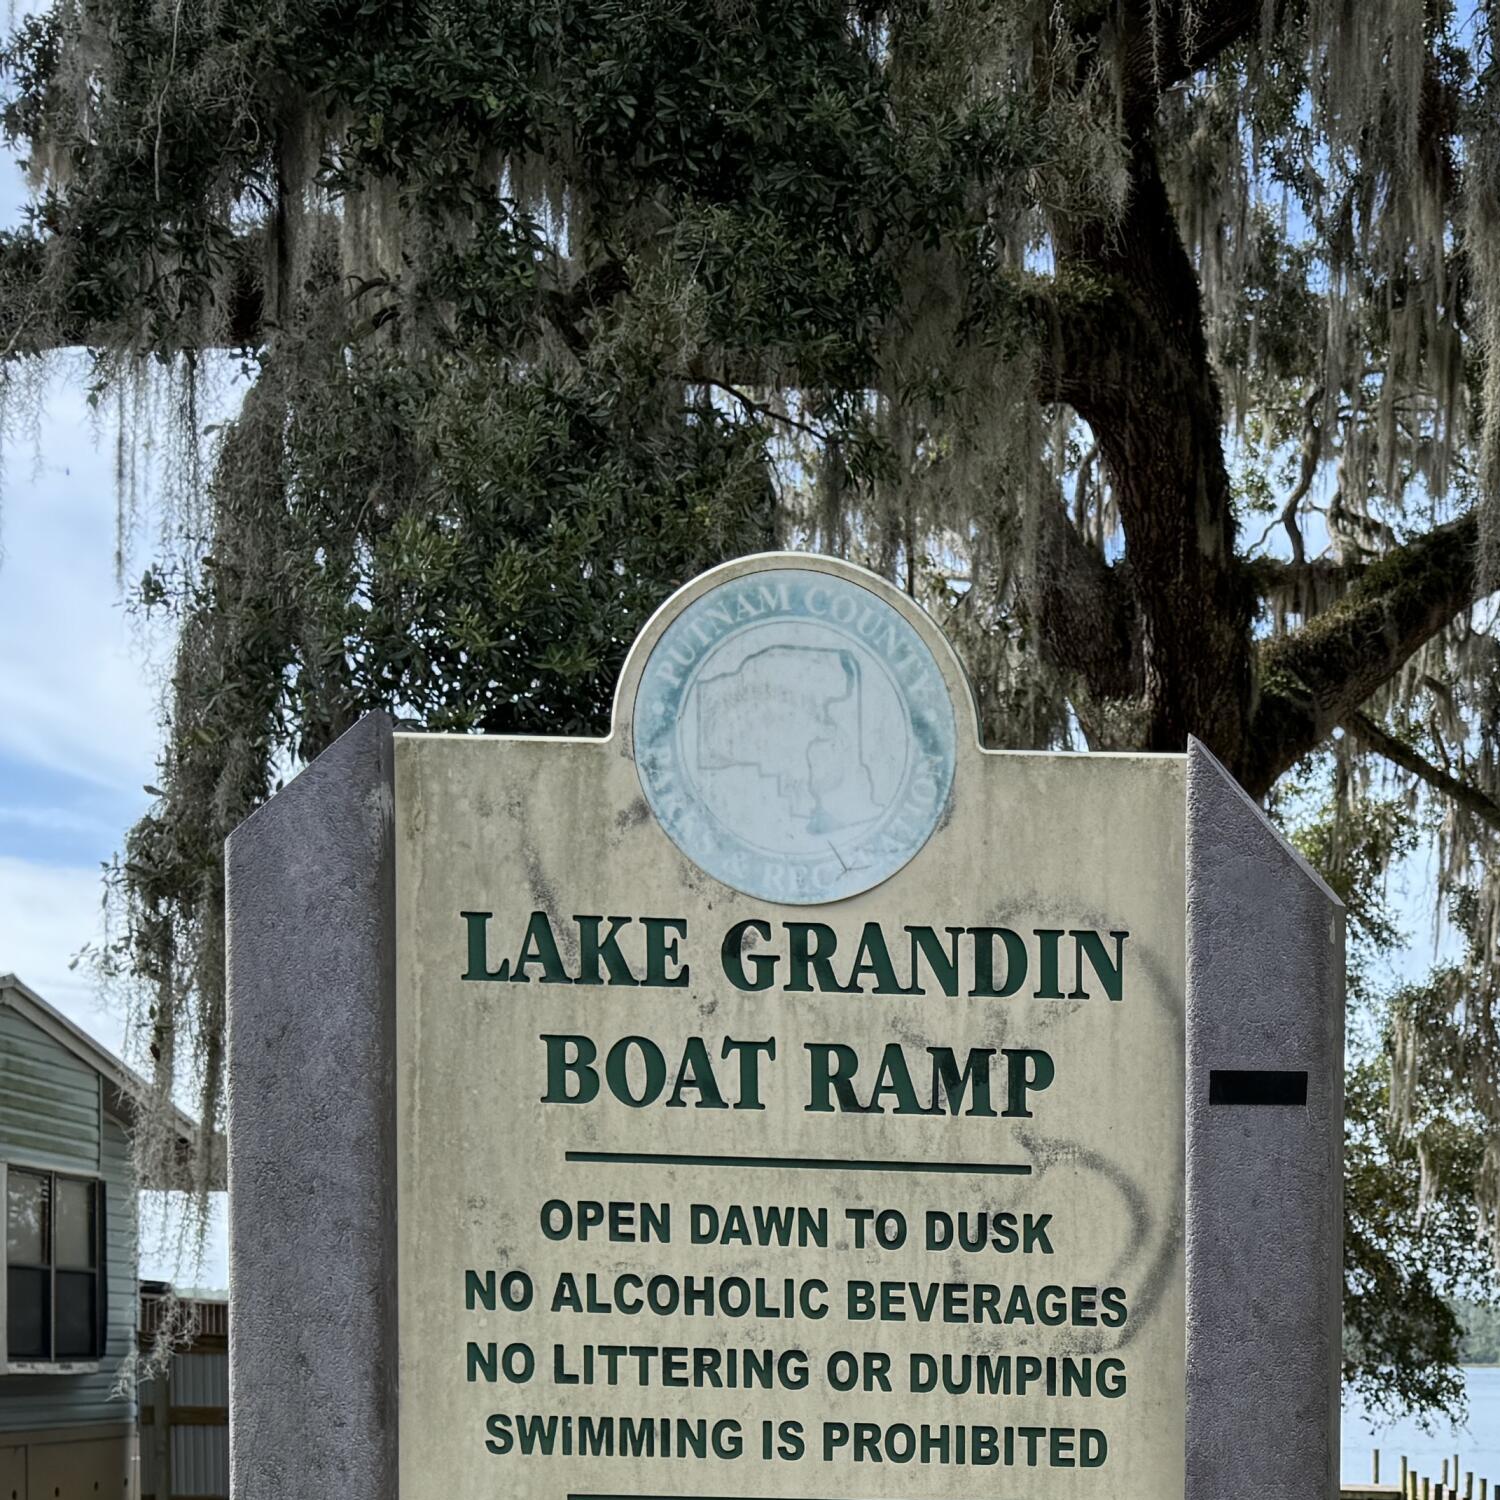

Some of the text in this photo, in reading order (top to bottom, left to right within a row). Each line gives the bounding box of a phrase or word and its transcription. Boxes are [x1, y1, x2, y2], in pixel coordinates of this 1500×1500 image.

[658, 582, 931, 699] PUTNAM COUNTY
[763, 752, 944, 893] RECATION
[459, 910, 1130, 1002] LAKE GRANDIN
[539, 1033, 1055, 1119] BOAT RAMP
[540, 1198, 1054, 1254] OPEN DAWN TO DUSK
[465, 1269, 1128, 1328] NO ALCOHOLIC BEVERAGES
[466, 1341, 1127, 1399] NO LITTERING OR DUMPING
[485, 1413, 1108, 1468] SWIMMING IS PROHIBITED
